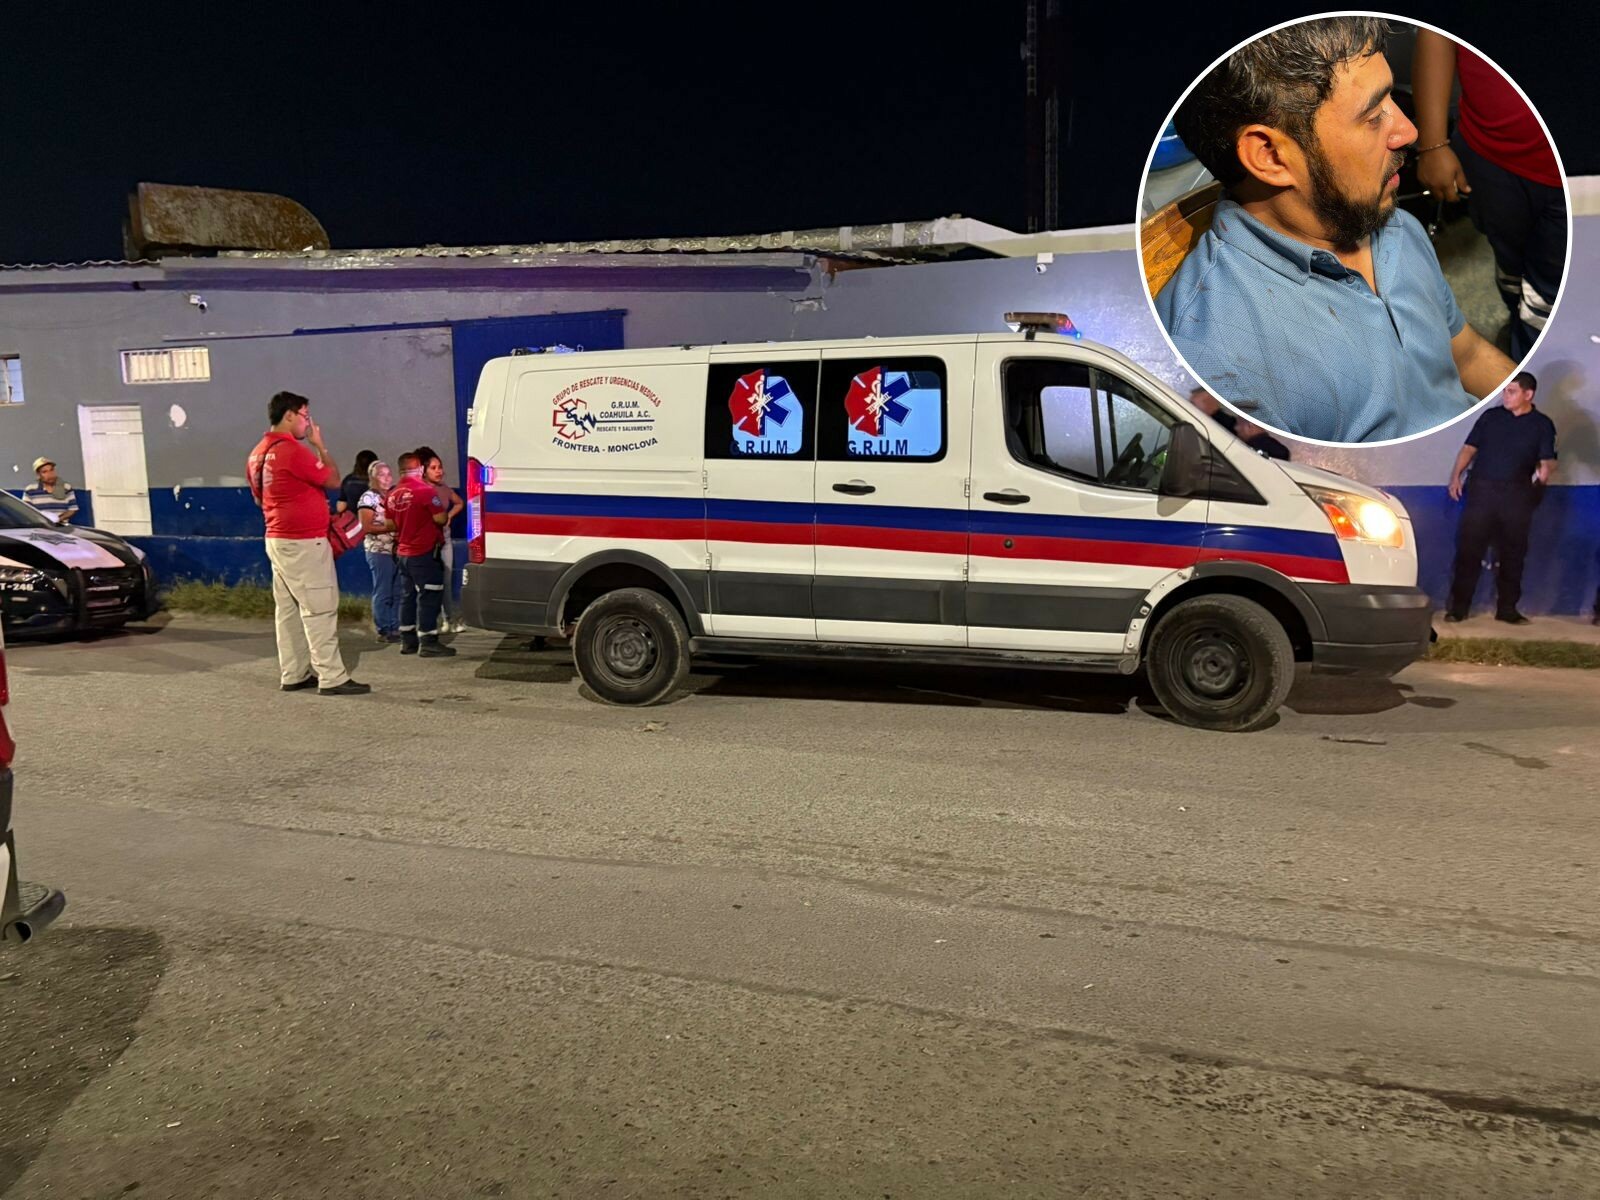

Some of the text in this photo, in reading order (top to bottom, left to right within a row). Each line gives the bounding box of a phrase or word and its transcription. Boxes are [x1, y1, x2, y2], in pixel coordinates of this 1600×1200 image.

[552, 376, 661, 407] GRUPO DE RESCATE Y URGENCIAS MEDICAS
[637, 410, 651, 418] A.C.
[552, 437, 600, 453] FRONTERA
[608, 437, 658, 453] MONCLOVA
